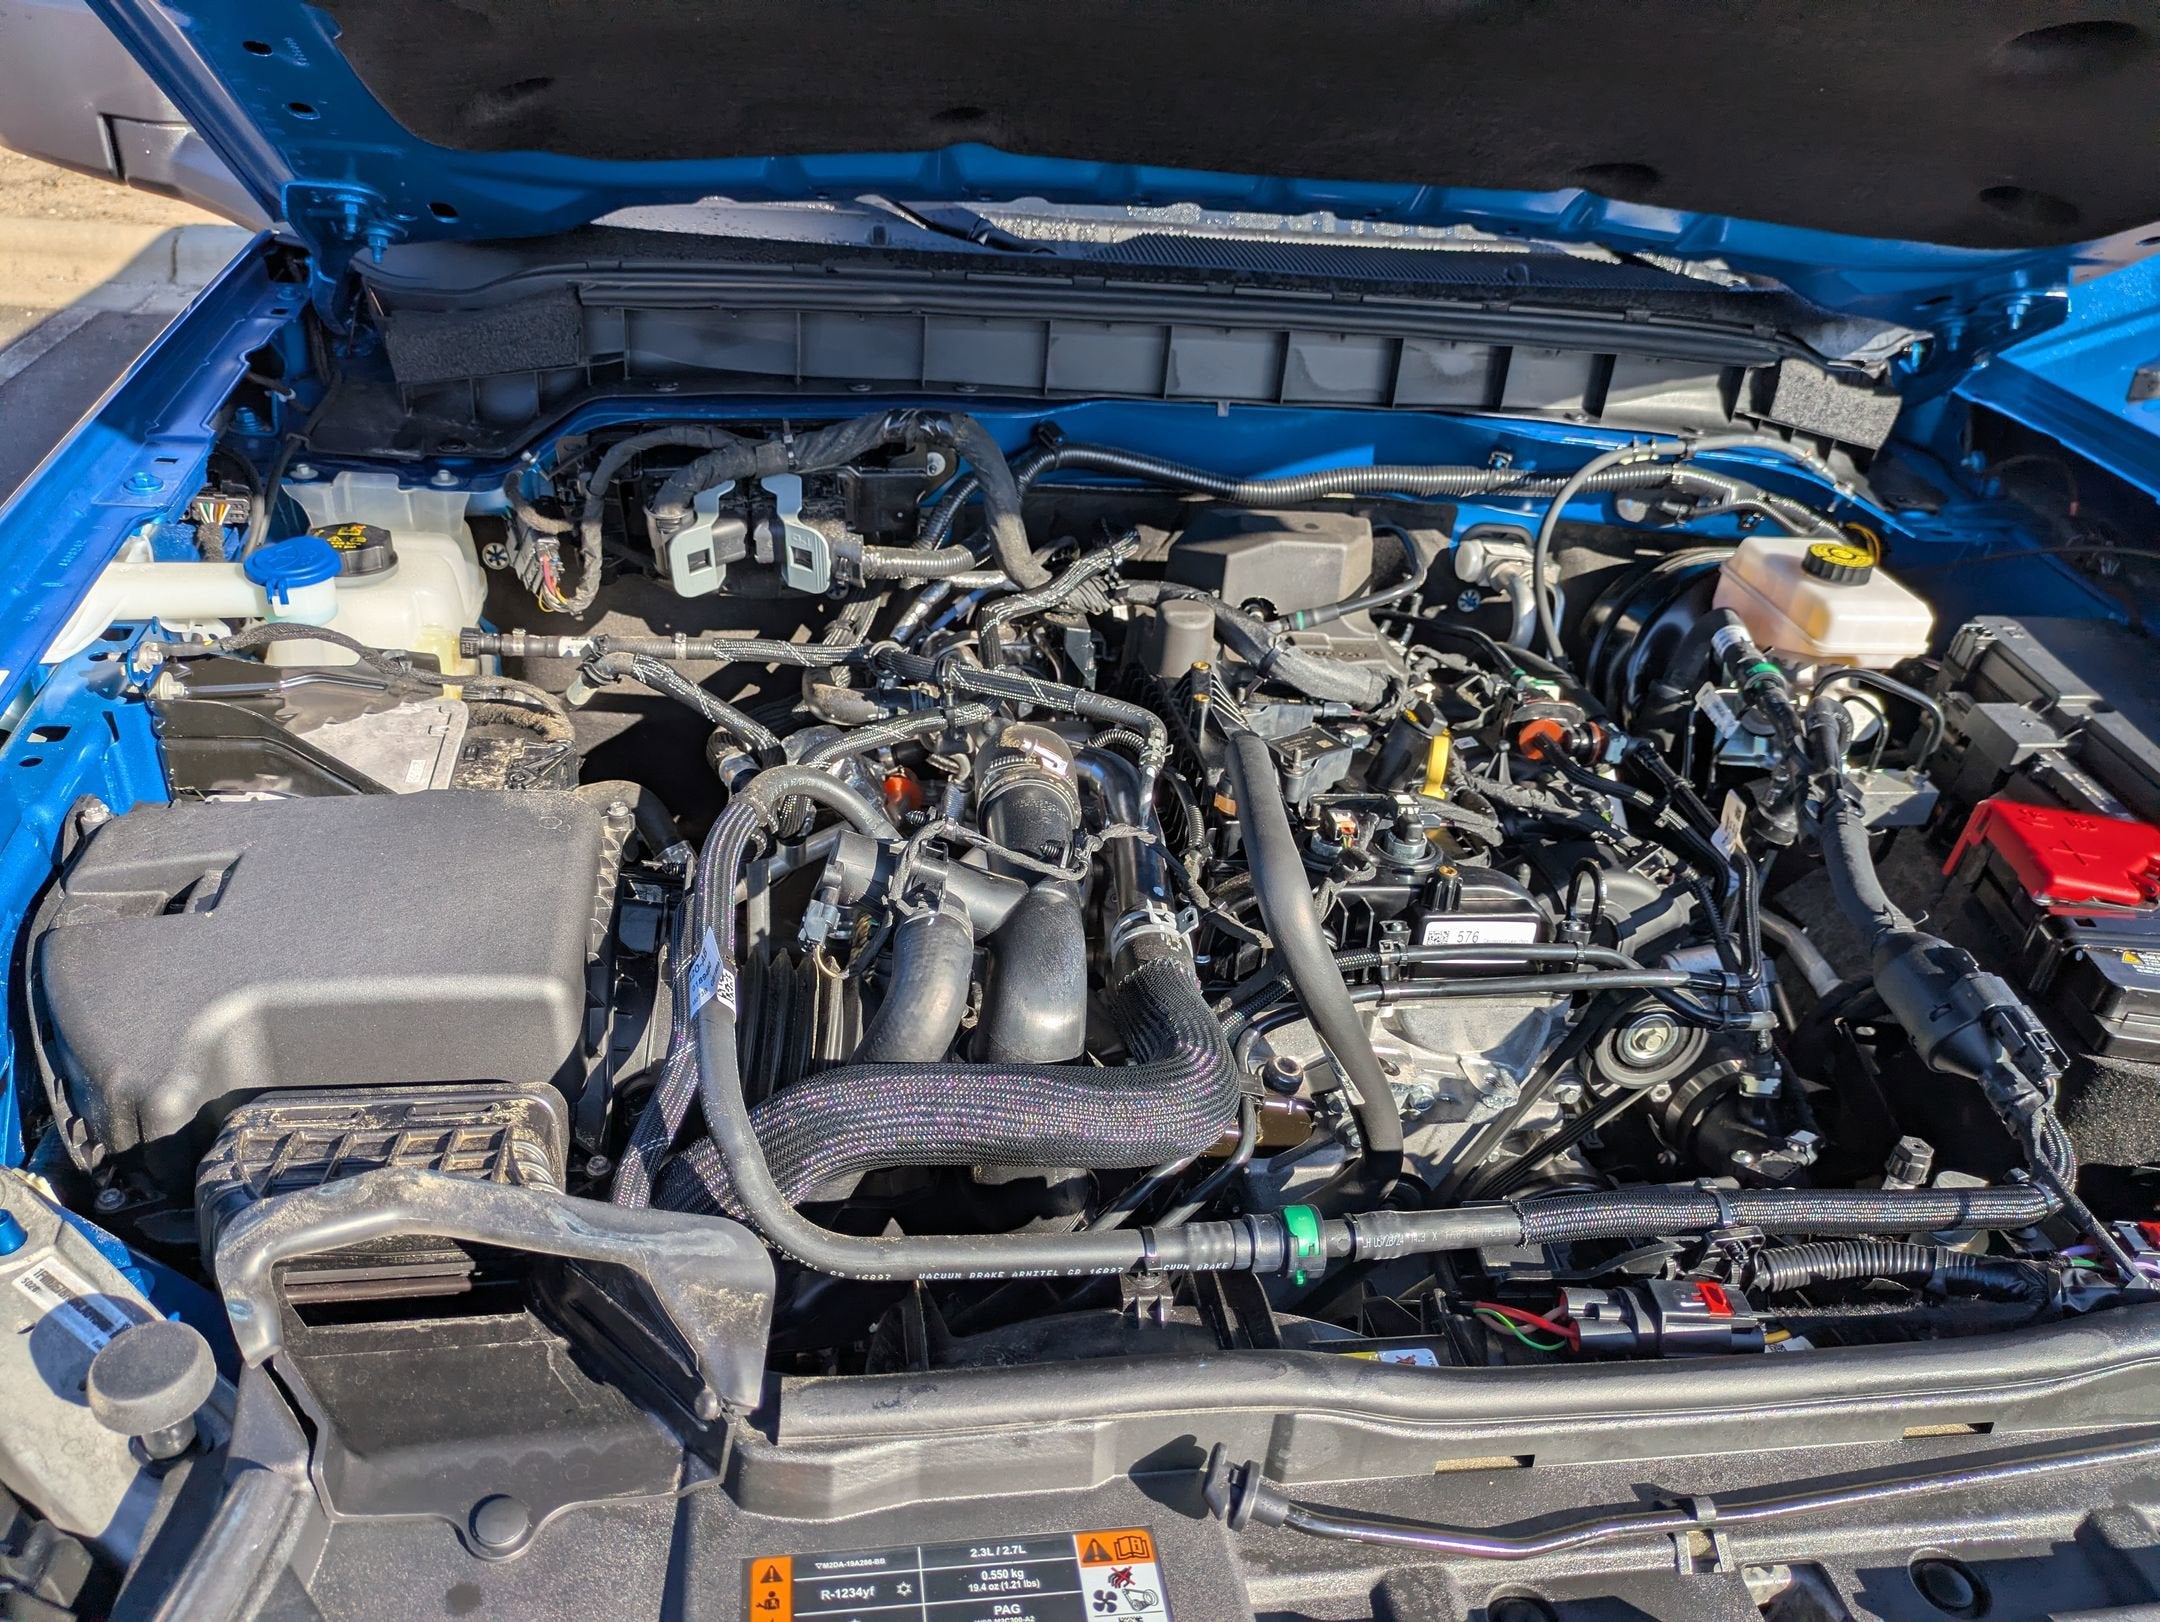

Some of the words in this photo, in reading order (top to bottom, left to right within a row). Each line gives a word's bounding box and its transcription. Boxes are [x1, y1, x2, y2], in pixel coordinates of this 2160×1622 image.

[1457, 931, 1479, 943] 576
[918, 1272, 962, 1280] VACUUM
[969, 1271, 1005, 1279] BRAKE
[1012, 1269, 1059, 1278] ARNITEL
[1197, 1262, 1229, 1271] BRAKE
[970, 1548, 994, 1558] 2.3L
[1002, 1545, 1027, 1555] 2.7L
[981, 1569, 1008, 1580] 0.550
[1010, 1569, 1024, 1580] kg
[968, 1583, 986, 1592] 19.4
[988, 1583, 999, 1591] oz
[1001, 1580, 1021, 1591] (1.21
[1023, 1578, 1041, 1588] lbs)
[820, 1585, 876, 1600] R-1234yf
[994, 1604, 1021, 1615] PAG
